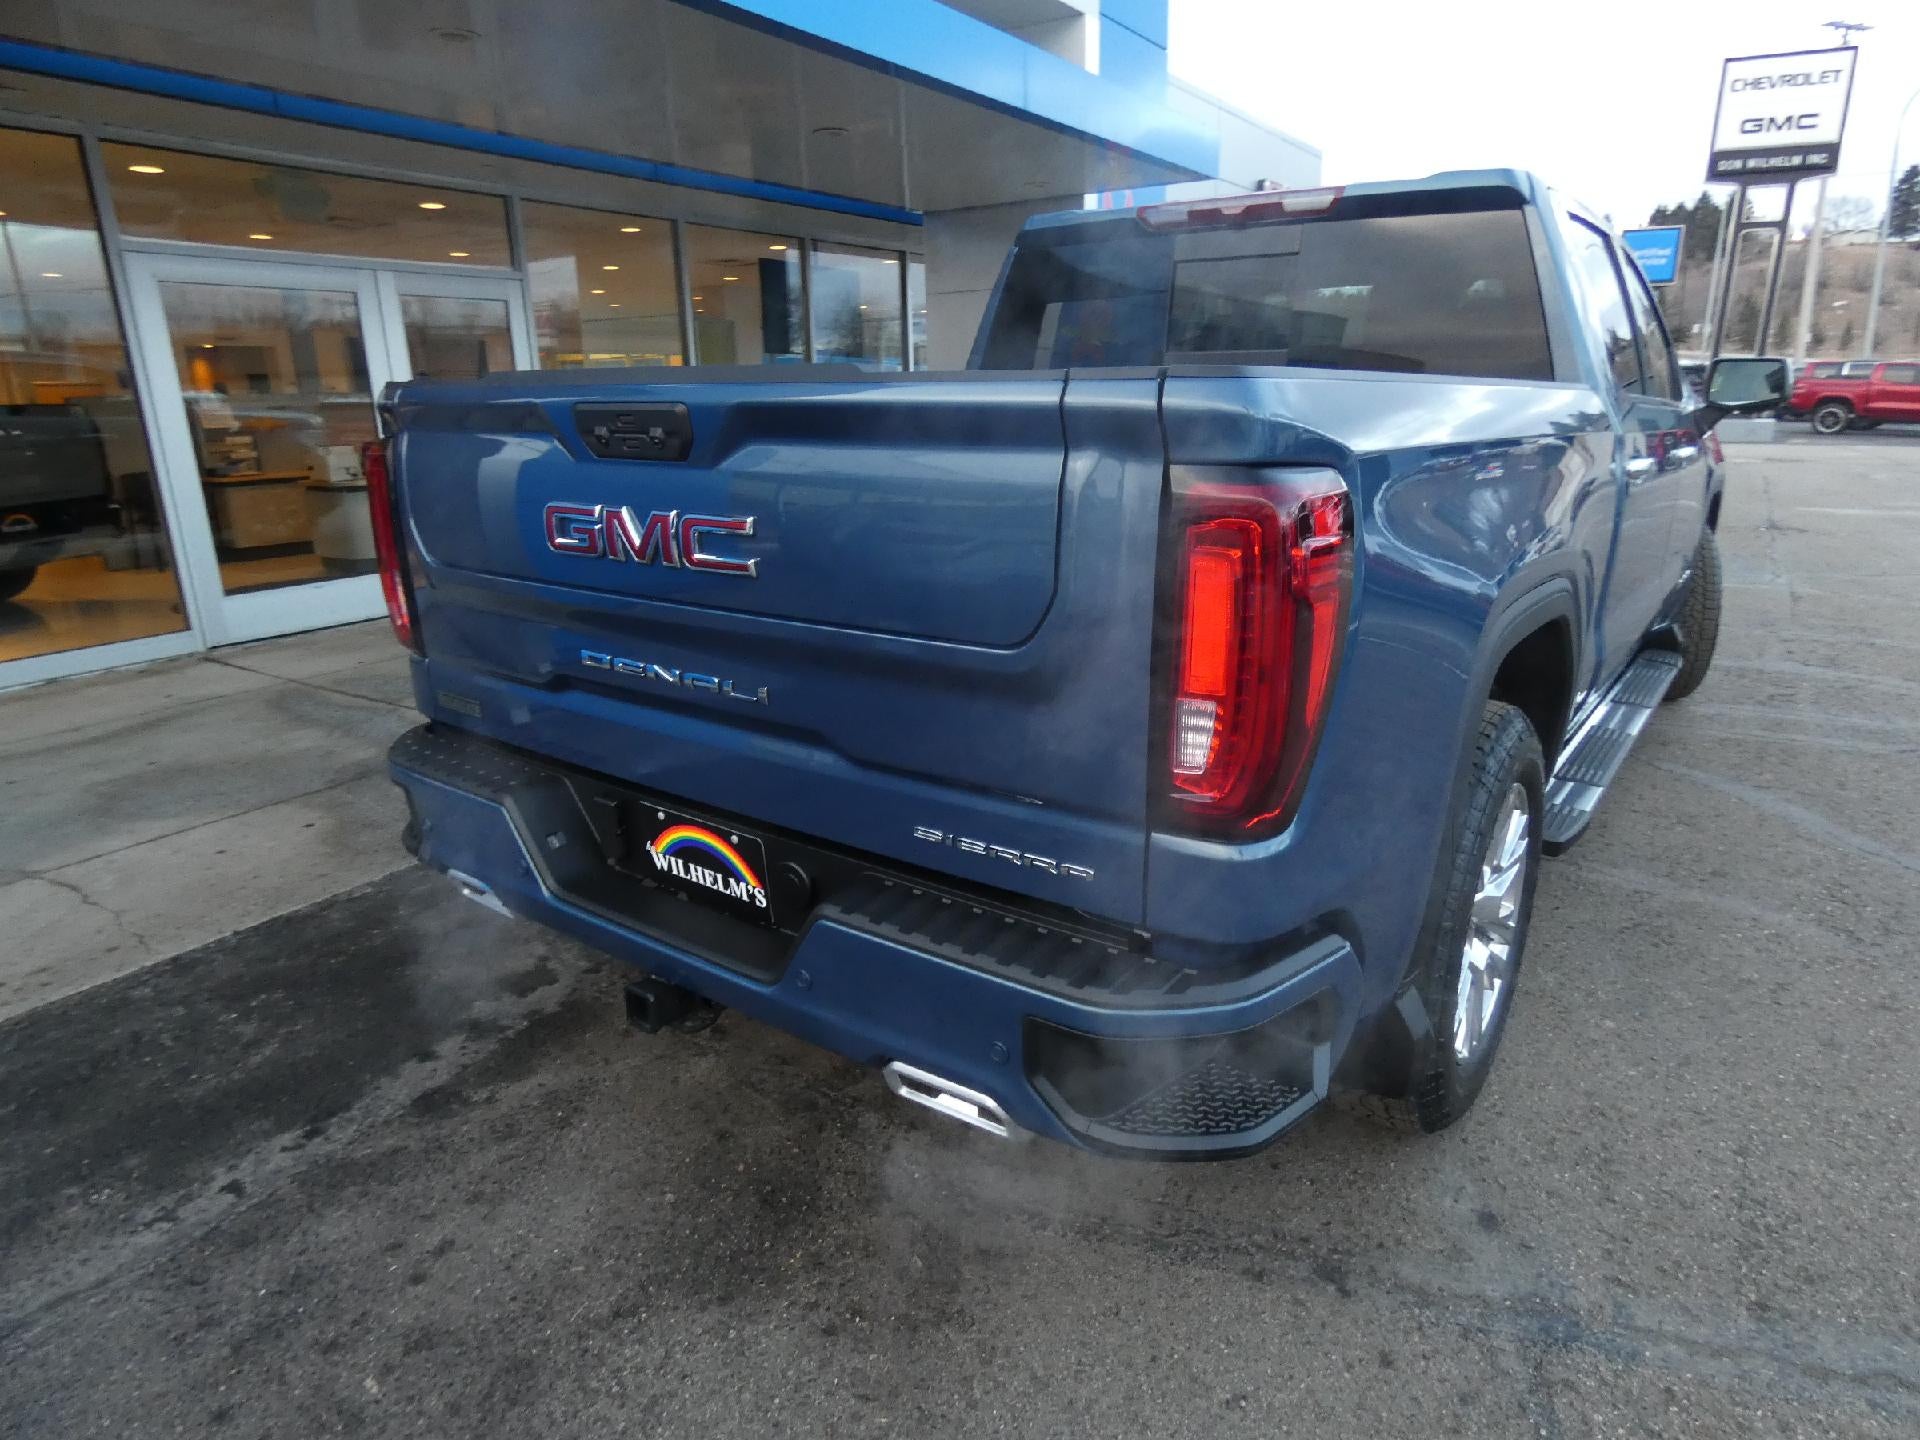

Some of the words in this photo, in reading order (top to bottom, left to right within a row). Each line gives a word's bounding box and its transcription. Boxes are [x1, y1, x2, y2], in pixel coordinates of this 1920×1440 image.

[1731, 70, 1843, 92] CHEVROLET
[1740, 113, 1820, 134] GMC
[543, 501, 760, 578] GMC
[580, 649, 769, 706] DENALI
[646, 841, 767, 908] WILHELM'S
[913, 825, 1095, 881] SIERRA
